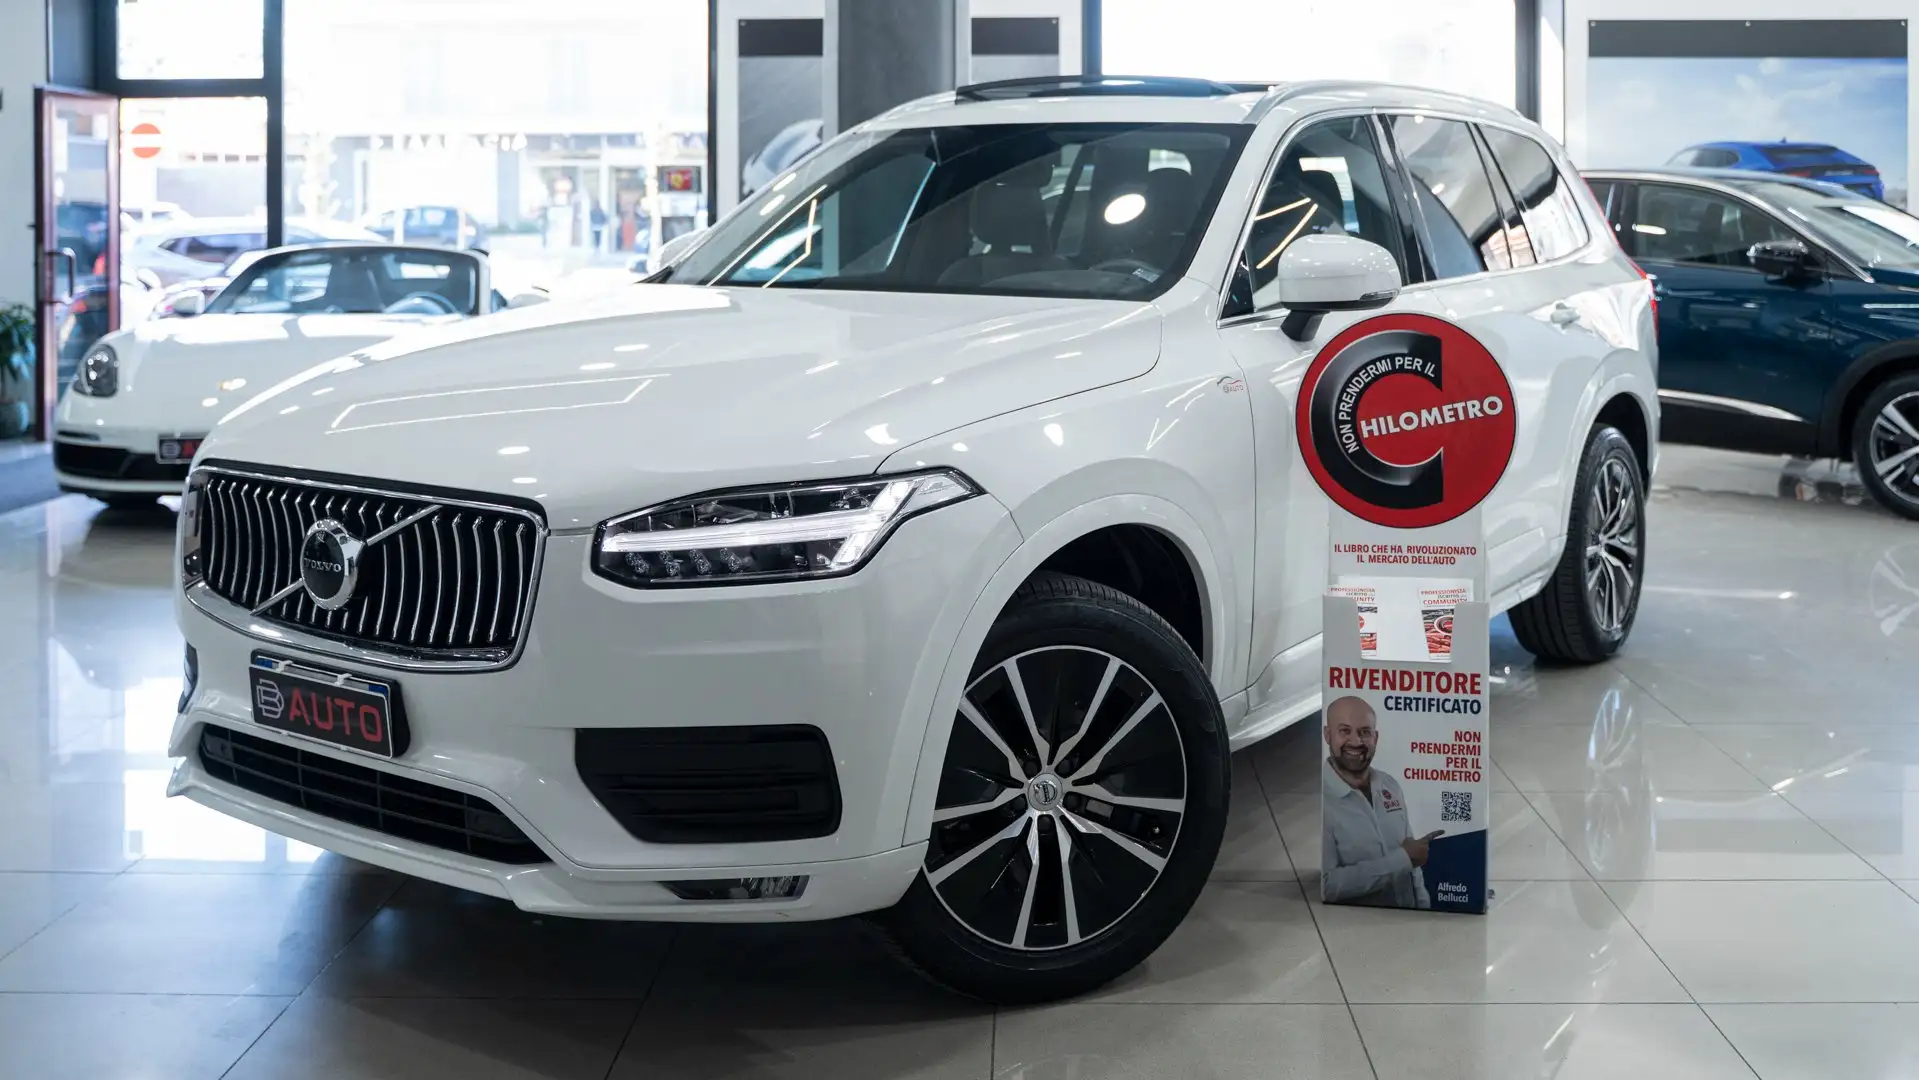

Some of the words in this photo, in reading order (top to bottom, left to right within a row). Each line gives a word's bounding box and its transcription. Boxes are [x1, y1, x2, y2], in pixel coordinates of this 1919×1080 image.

[1395, 357, 1423, 371] PER
[1424, 362, 1436, 378] IL
[1339, 358, 1392, 420] PRENDERMI
[1339, 424, 1360, 453] NON
[1334, 544, 1342, 553] IL
[1344, 544, 1369, 553] LIBRO
[1371, 544, 1389, 554] CHE
[1390, 545, 1403, 554] HA
[1407, 545, 1476, 556] RIVOLUZIONATO
[304, 557, 342, 573] VOLVO
[1357, 554, 1364, 563] IL
[1368, 555, 1409, 564] MERCATO
[1411, 555, 1456, 565] DELL'AUTO
[1329, 666, 1481, 695] RIVENDITORE
[1384, 695, 1481, 715] CERTIFICATO
[289, 688, 383, 743] AUTO
[1454, 731, 1481, 743] NON
[1410, 742, 1481, 756] PRENDERMI
[1446, 757, 1469, 769] PER
[1471, 758, 1482, 769] IL
[1404, 767, 1481, 782] CHILOMETRO
[1437, 882, 1467, 893] Alfredo
[1437, 892, 1469, 903] Bellucci
